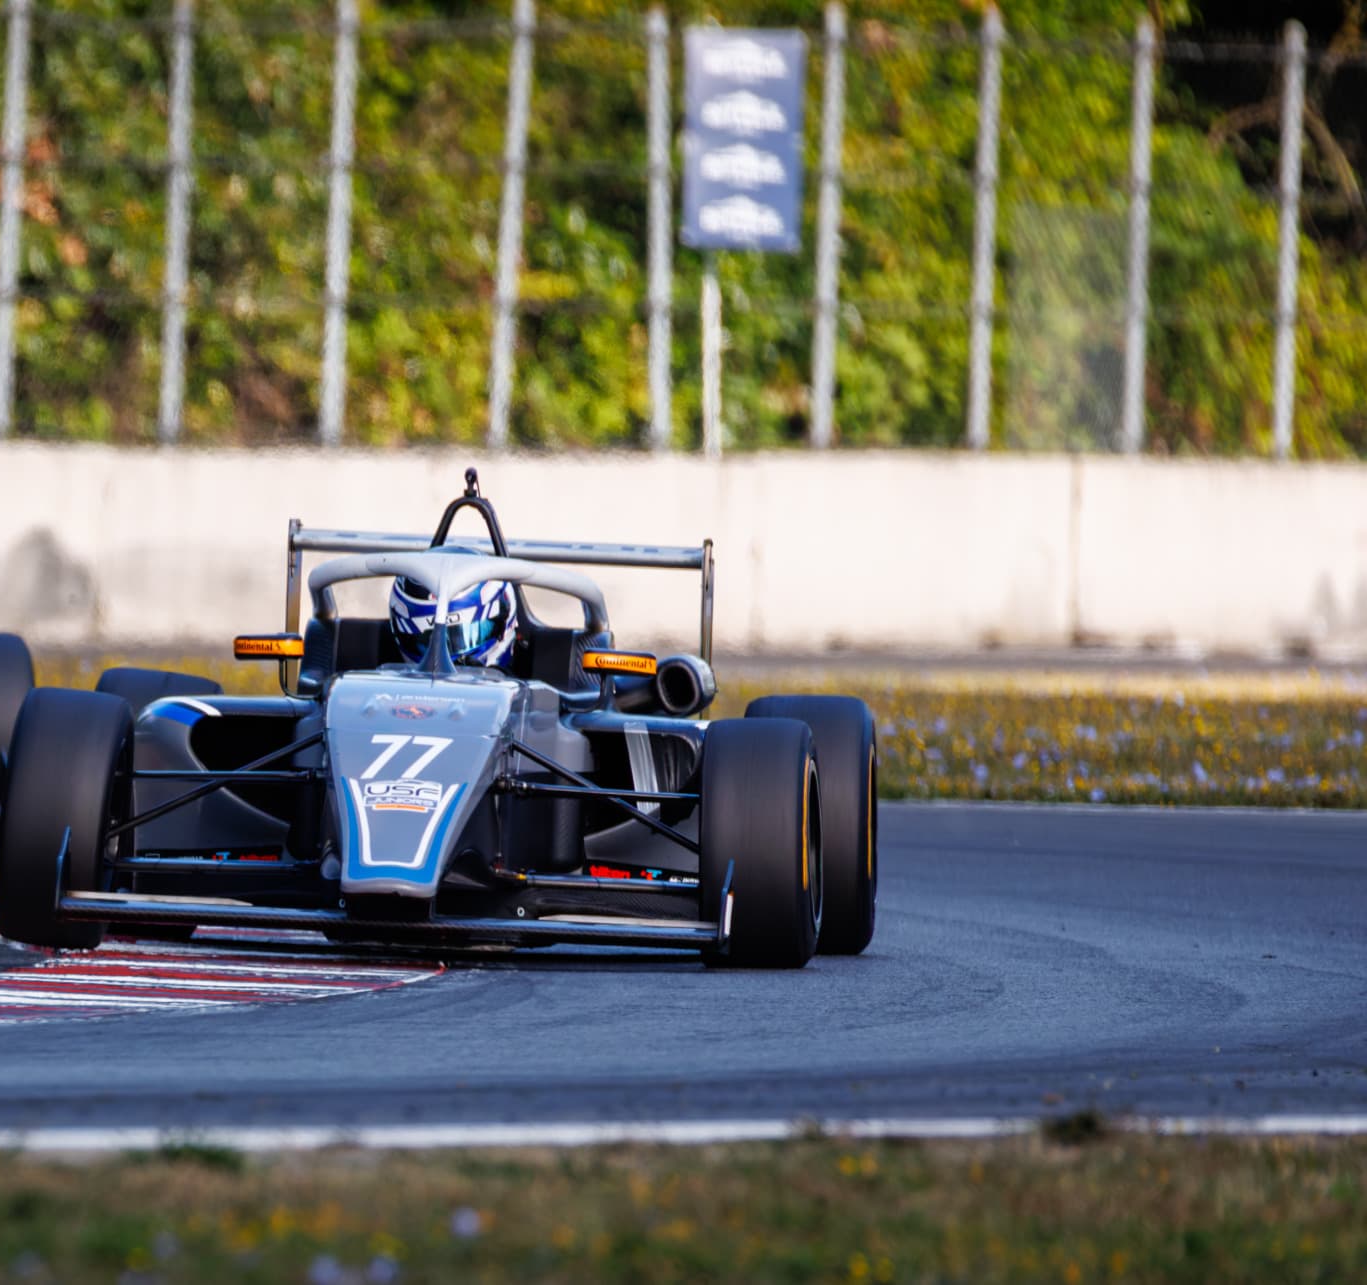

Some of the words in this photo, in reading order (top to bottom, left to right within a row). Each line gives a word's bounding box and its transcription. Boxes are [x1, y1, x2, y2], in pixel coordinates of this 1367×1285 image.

[595, 655, 647, 670] Continental
[360, 734, 454, 780] 77
[367, 785, 440, 797] USF
